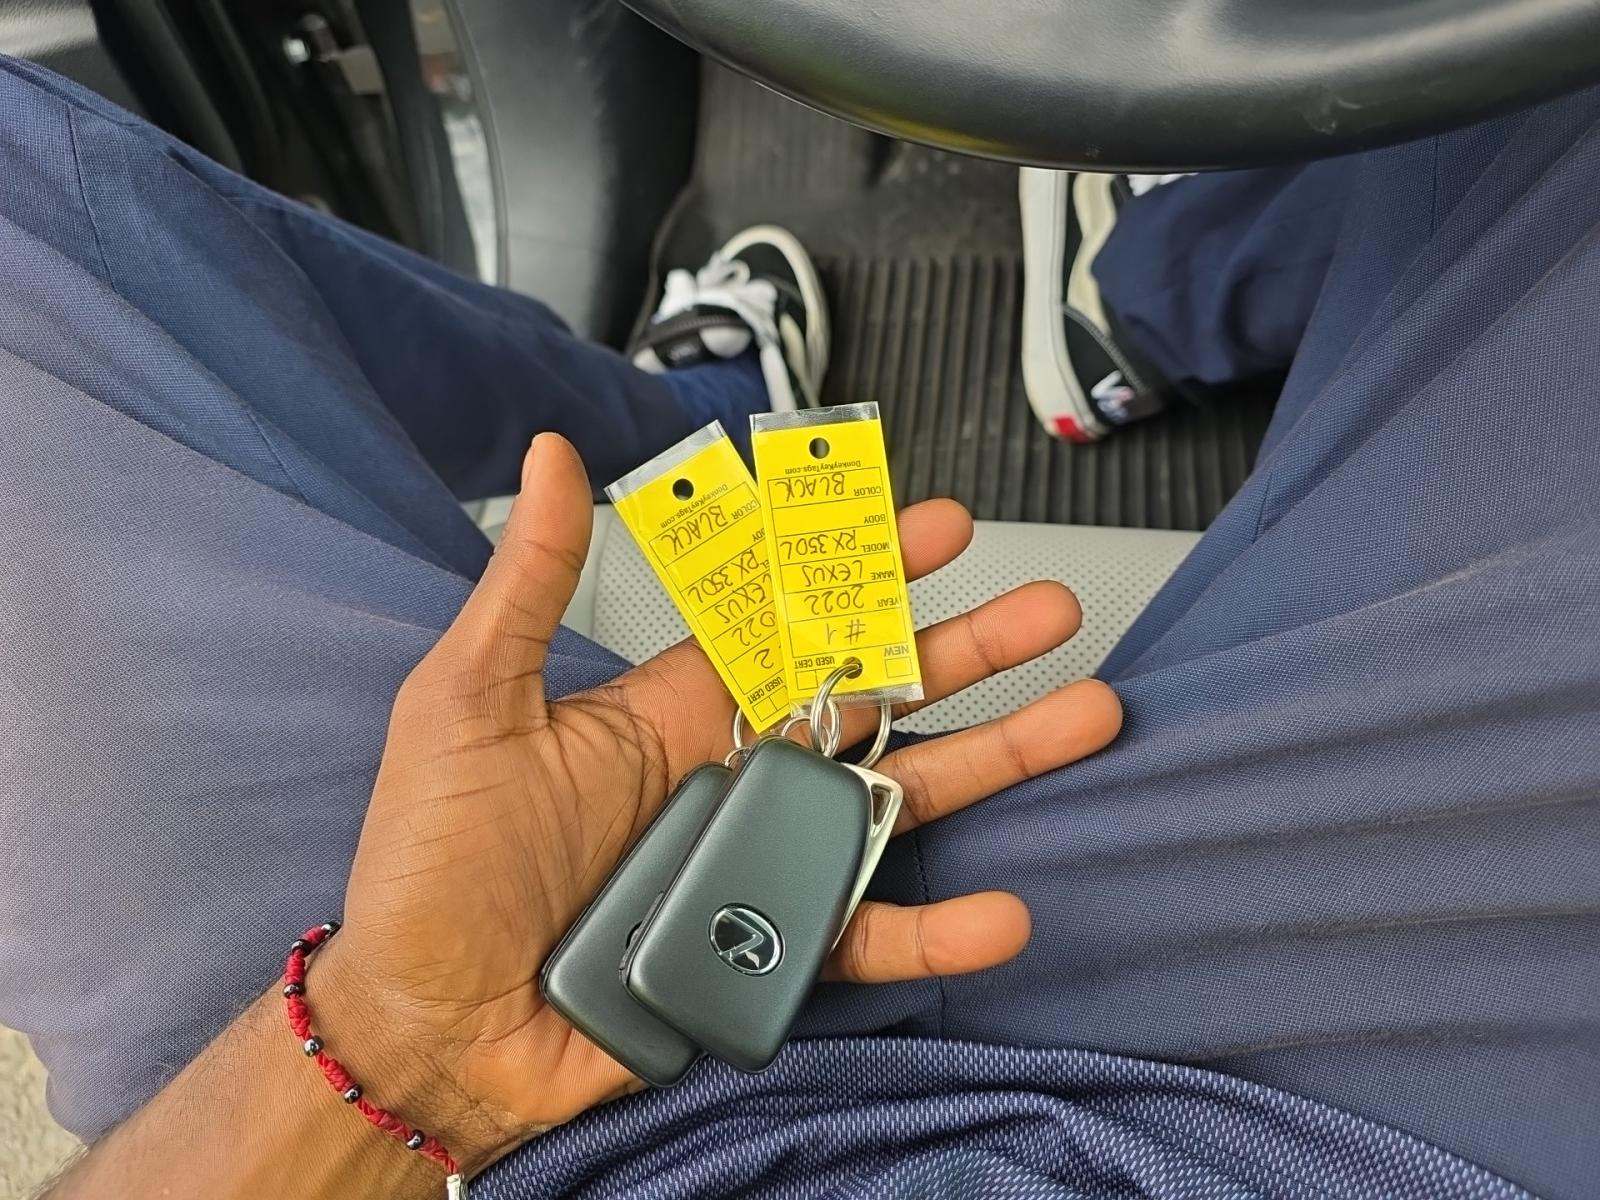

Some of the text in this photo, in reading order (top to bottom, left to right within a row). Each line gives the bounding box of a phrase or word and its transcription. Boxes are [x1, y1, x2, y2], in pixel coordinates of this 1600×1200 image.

[784, 460, 861, 475] DonkeyKeyTags.com
[774, 472, 845, 502] BLACK
[853, 486, 882, 496] COLOR
[660, 483, 728, 529] DonkeyKeyTags.com
[731, 500, 758, 520] COLOR
[660, 505, 728, 555] BLACK
[864, 514, 886, 524] BODY
[832, 530, 857, 555] RX
[860, 542, 890, 552] MODEL
[730, 548, 760, 582] RX
[801, 560, 862, 588] LEXUS
[870, 570, 895, 580] MAKE
[804, 584, 864, 616] 2022
[877, 597, 900, 608] YEAR
[731, 611, 776, 646] 022
[884, 644, 909, 656] NEW
[794, 656, 836, 669] USED CERT
[746, 676, 784, 704] USED CERT
